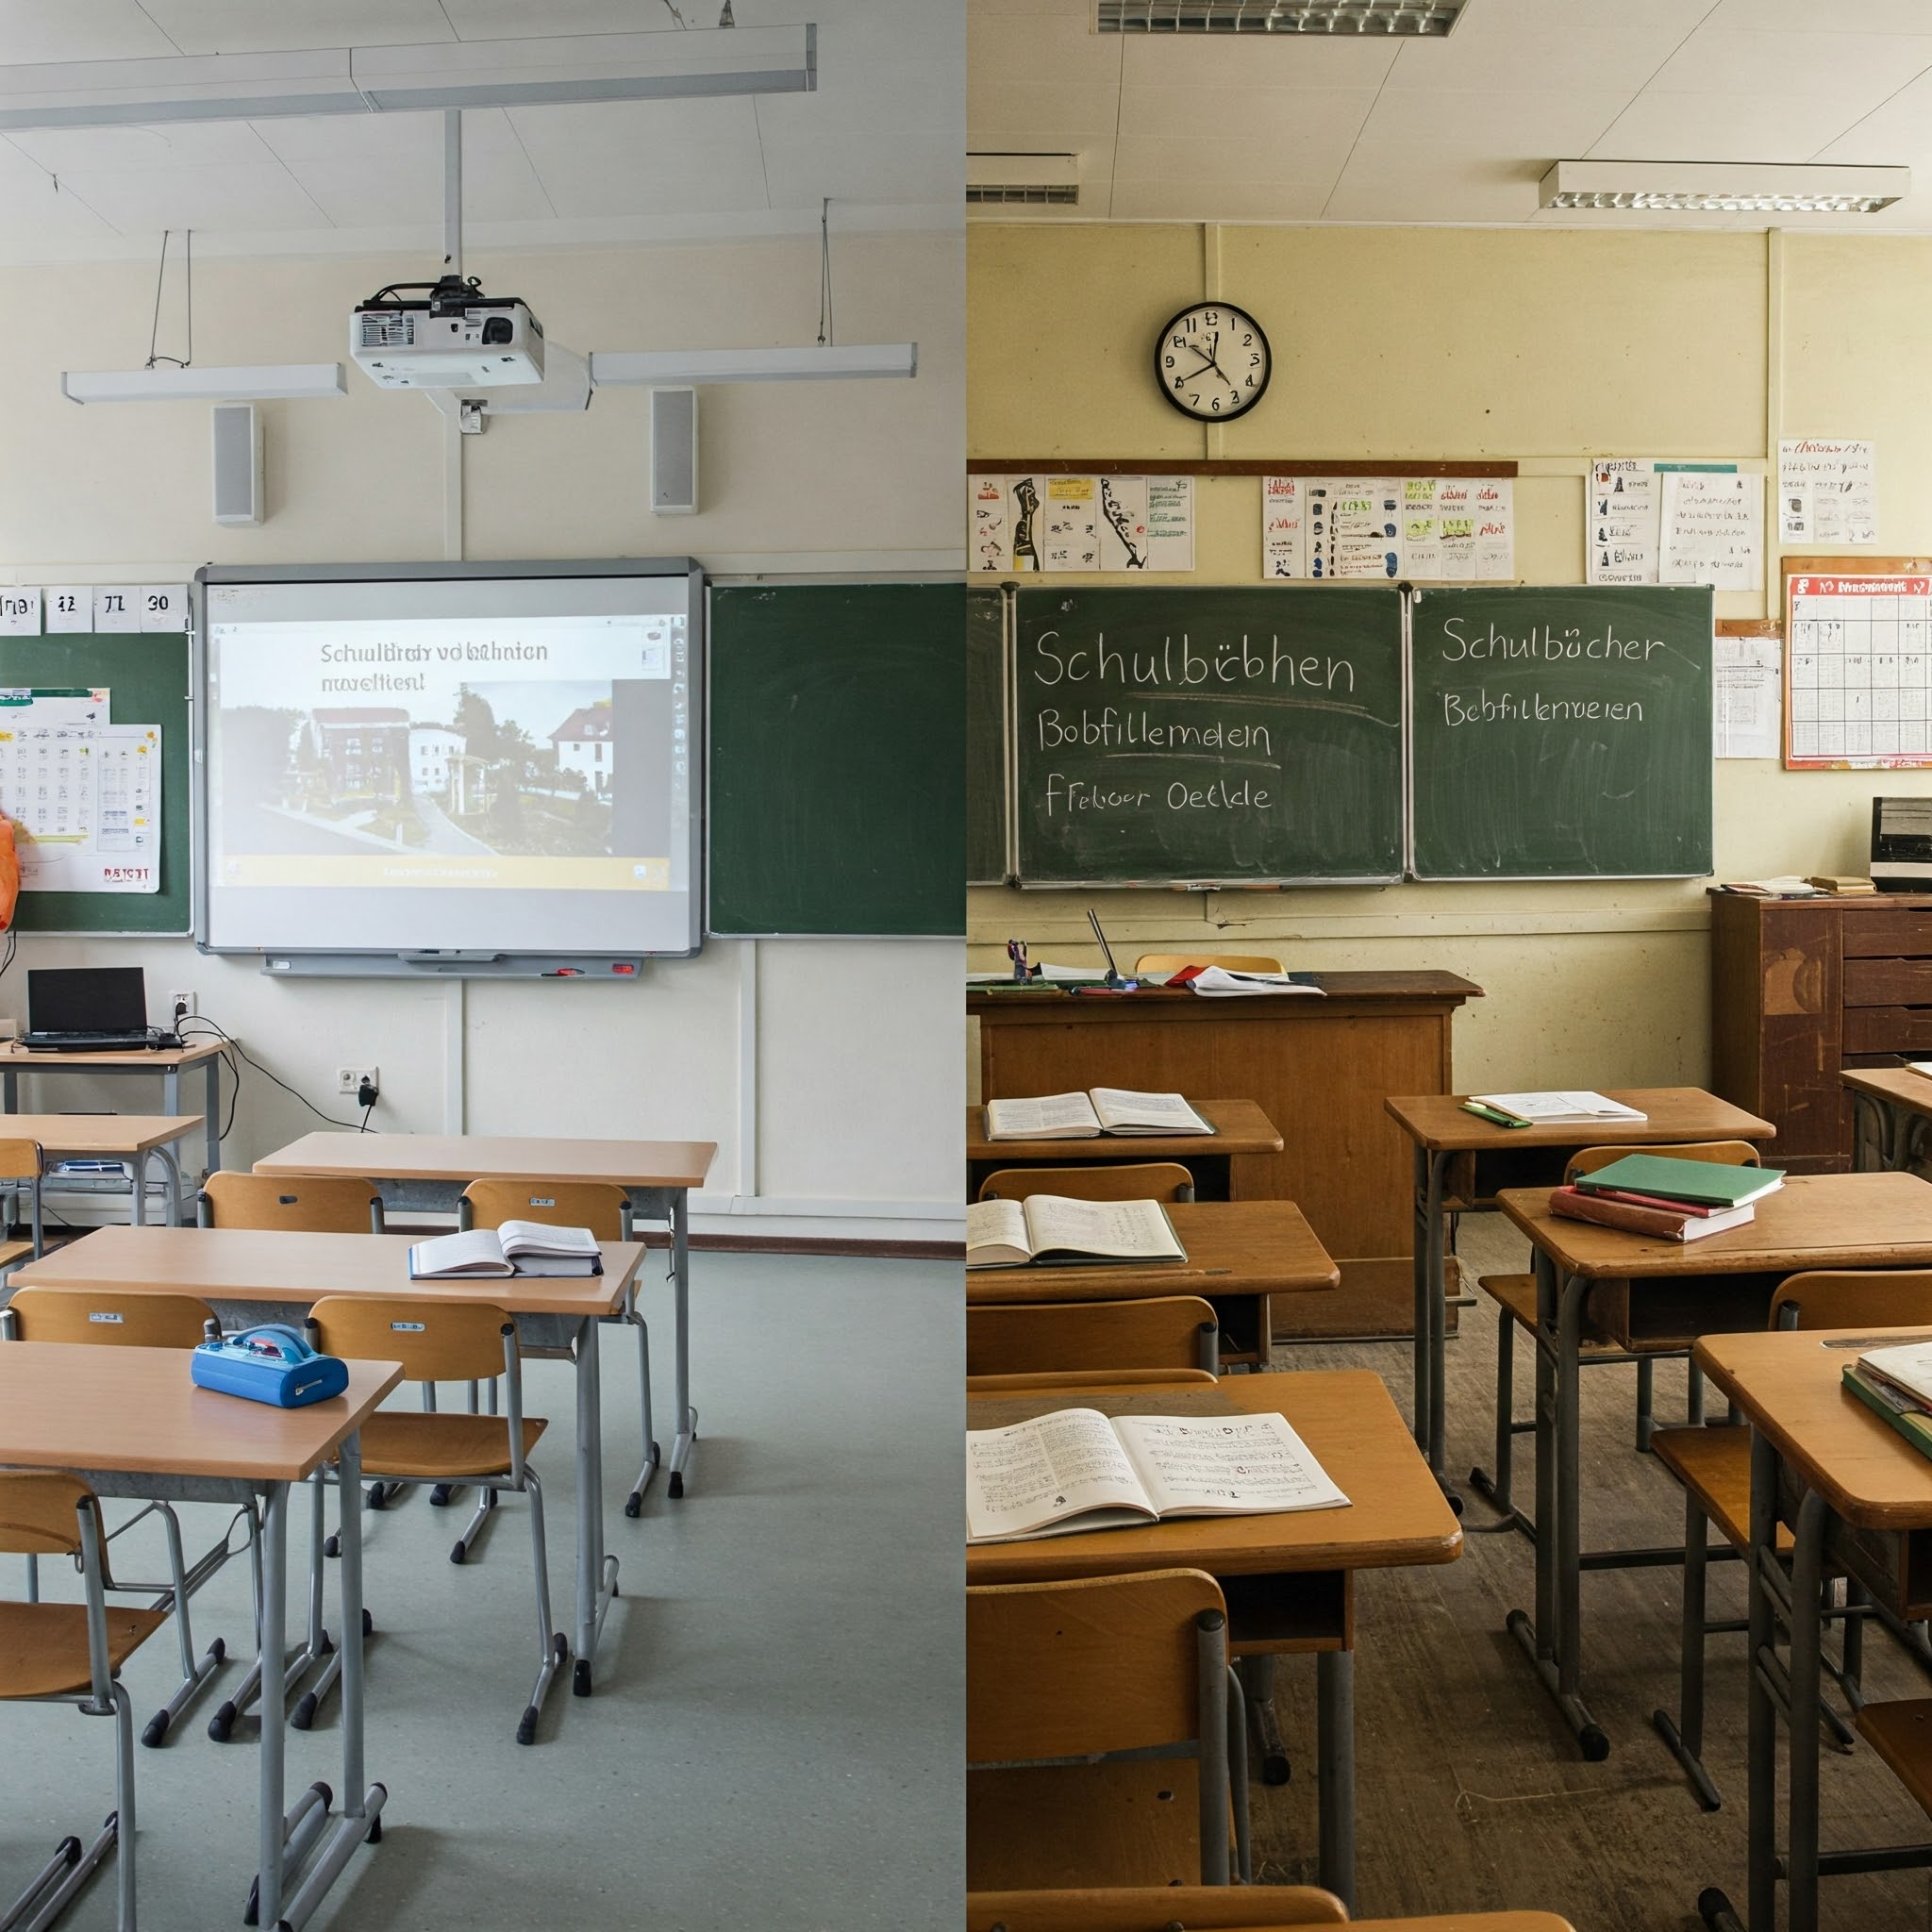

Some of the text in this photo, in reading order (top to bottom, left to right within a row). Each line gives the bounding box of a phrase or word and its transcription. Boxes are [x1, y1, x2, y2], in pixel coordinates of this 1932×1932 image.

[1187, 318, 1196, 332] 11
[1242, 334, 1252, 346] 2
[1189, 393, 1200, 407] 7
[1211, 397, 1220, 410] 6
[1442, 617, 1667, 661] Schulbücher
